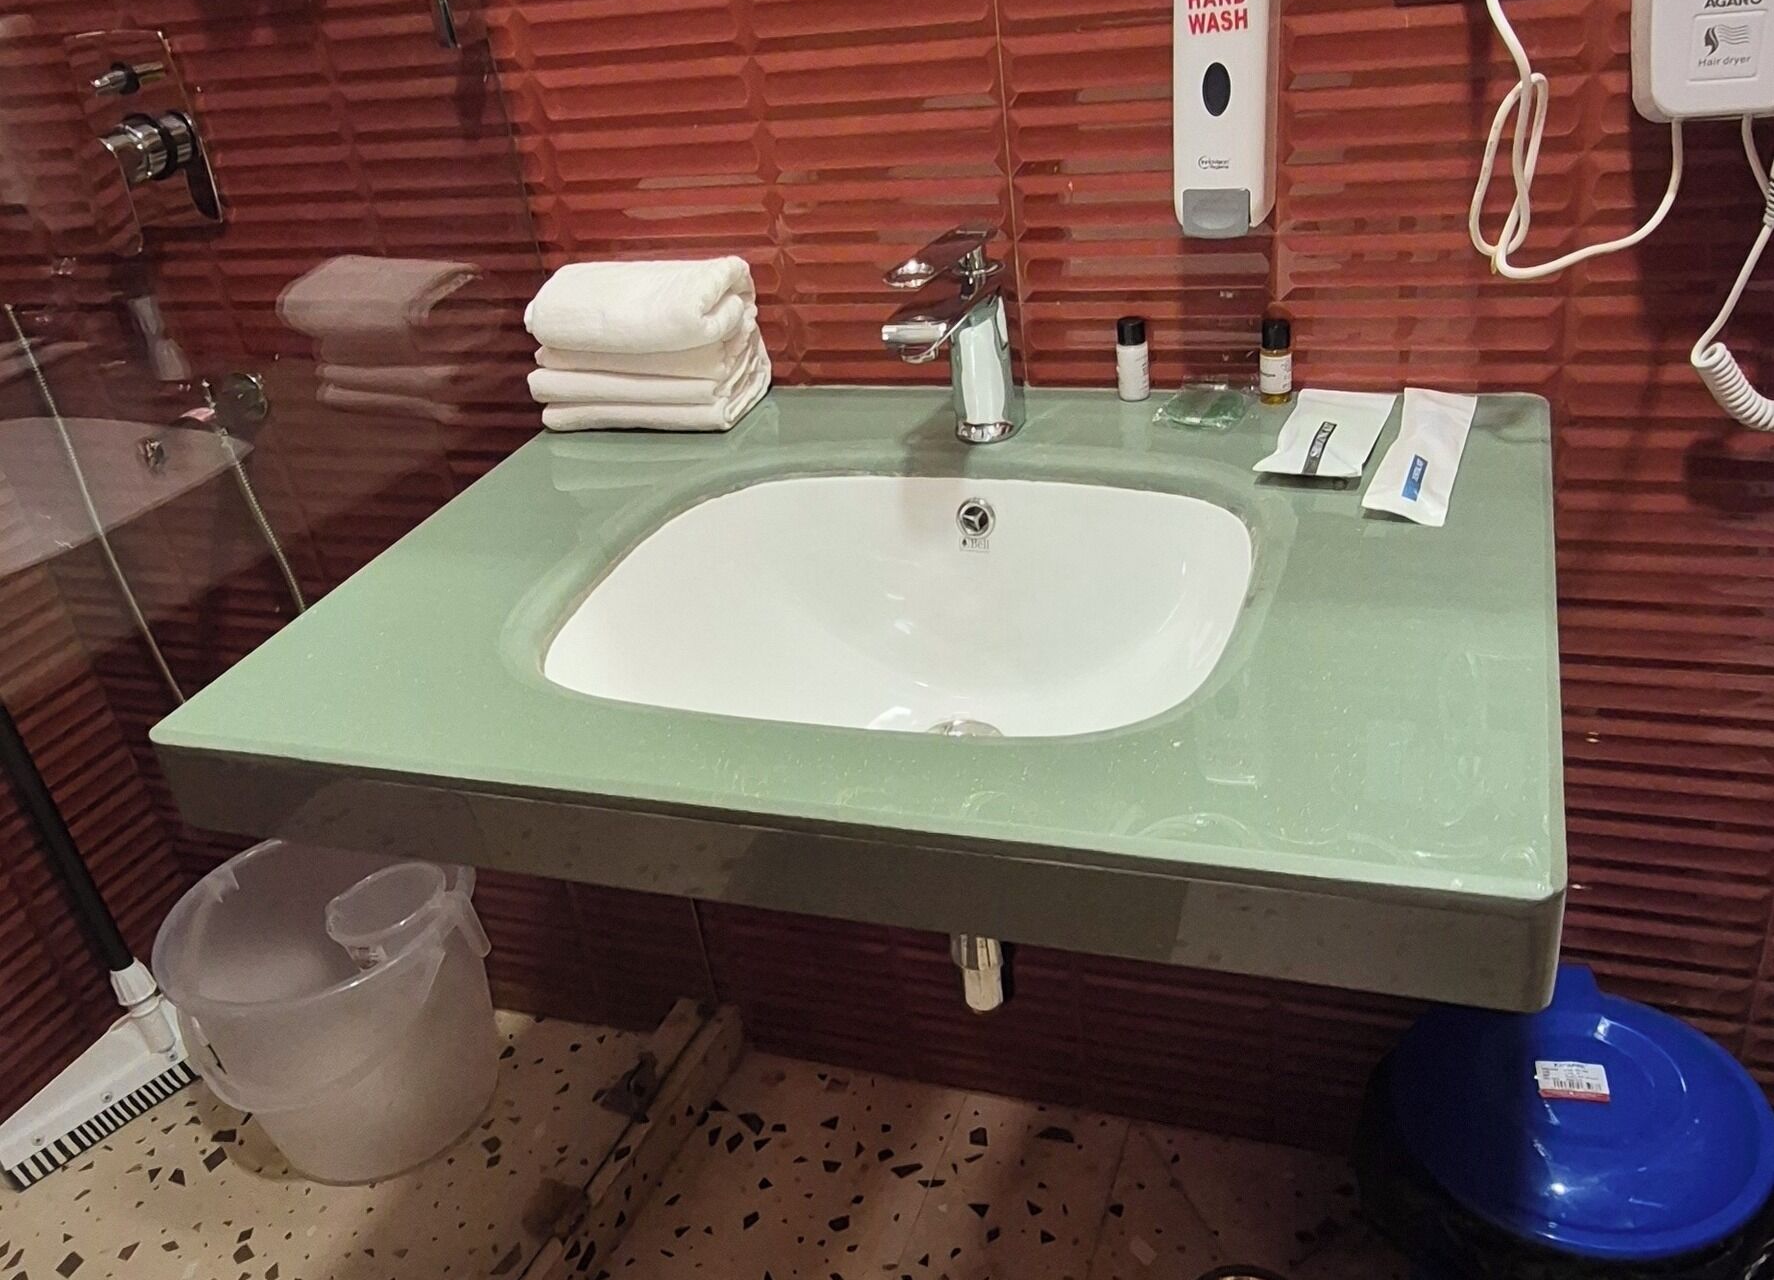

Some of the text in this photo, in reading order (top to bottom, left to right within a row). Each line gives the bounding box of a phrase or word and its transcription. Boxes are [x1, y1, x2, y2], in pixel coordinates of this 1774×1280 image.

[1188, 8, 1248, 35] WASH
[1698, 56, 1752, 67] Hair dryer
